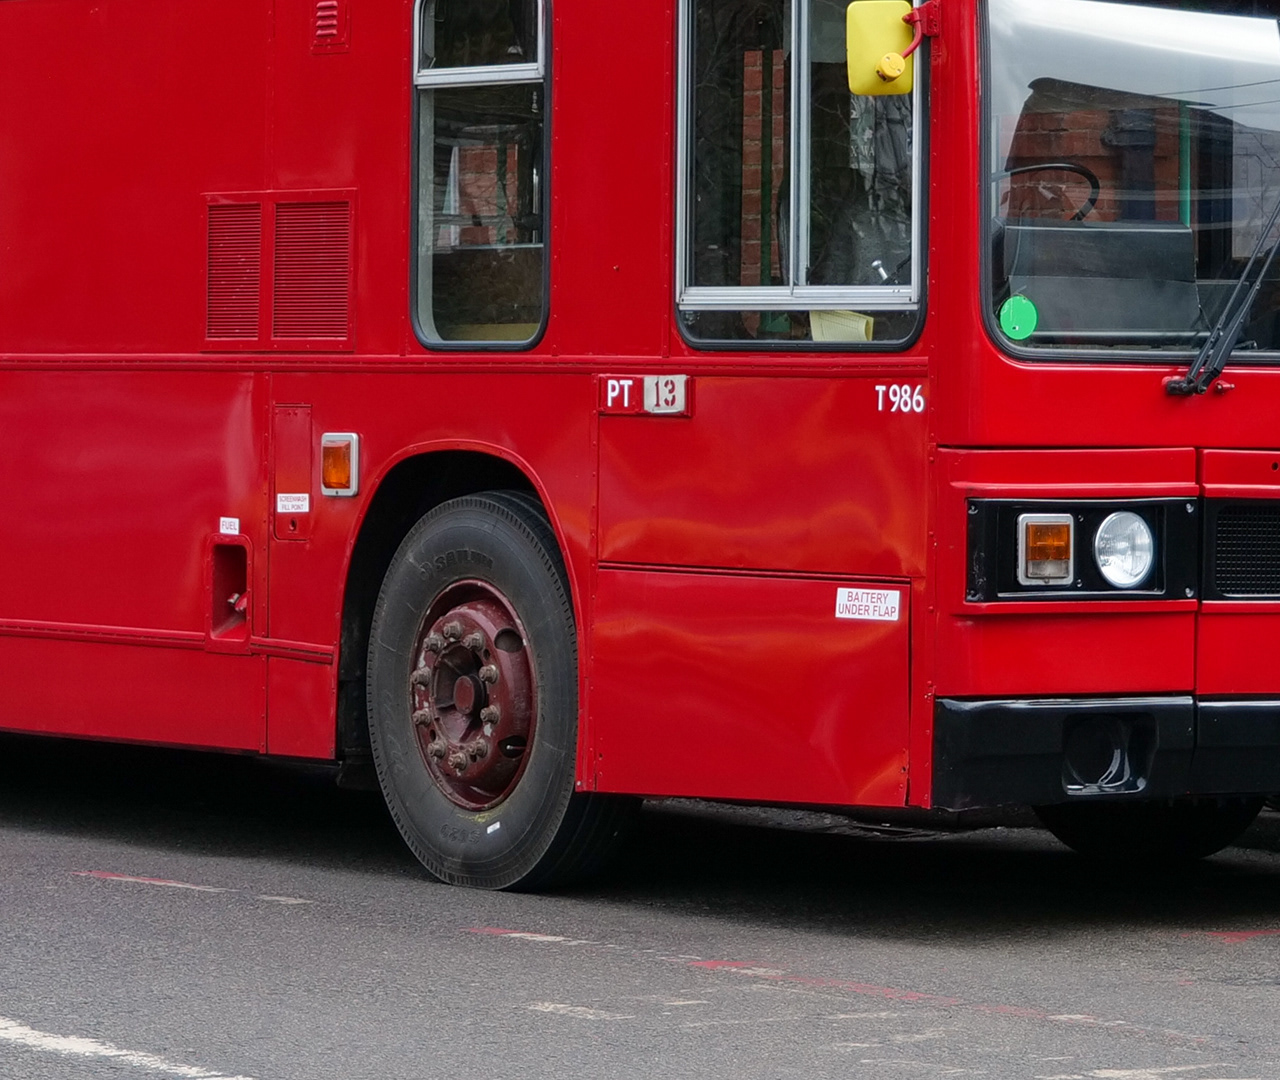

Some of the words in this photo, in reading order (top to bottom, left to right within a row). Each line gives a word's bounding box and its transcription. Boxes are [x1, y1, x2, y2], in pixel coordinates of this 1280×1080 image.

[607, 379, 634, 408] PT
[654, 379, 677, 408] 13
[221, 520, 238, 531] FUEL
[847, 591, 889, 605] BATTERY
[838, 603, 870, 616] UNDER
[872, 605, 897, 618] FLAP
